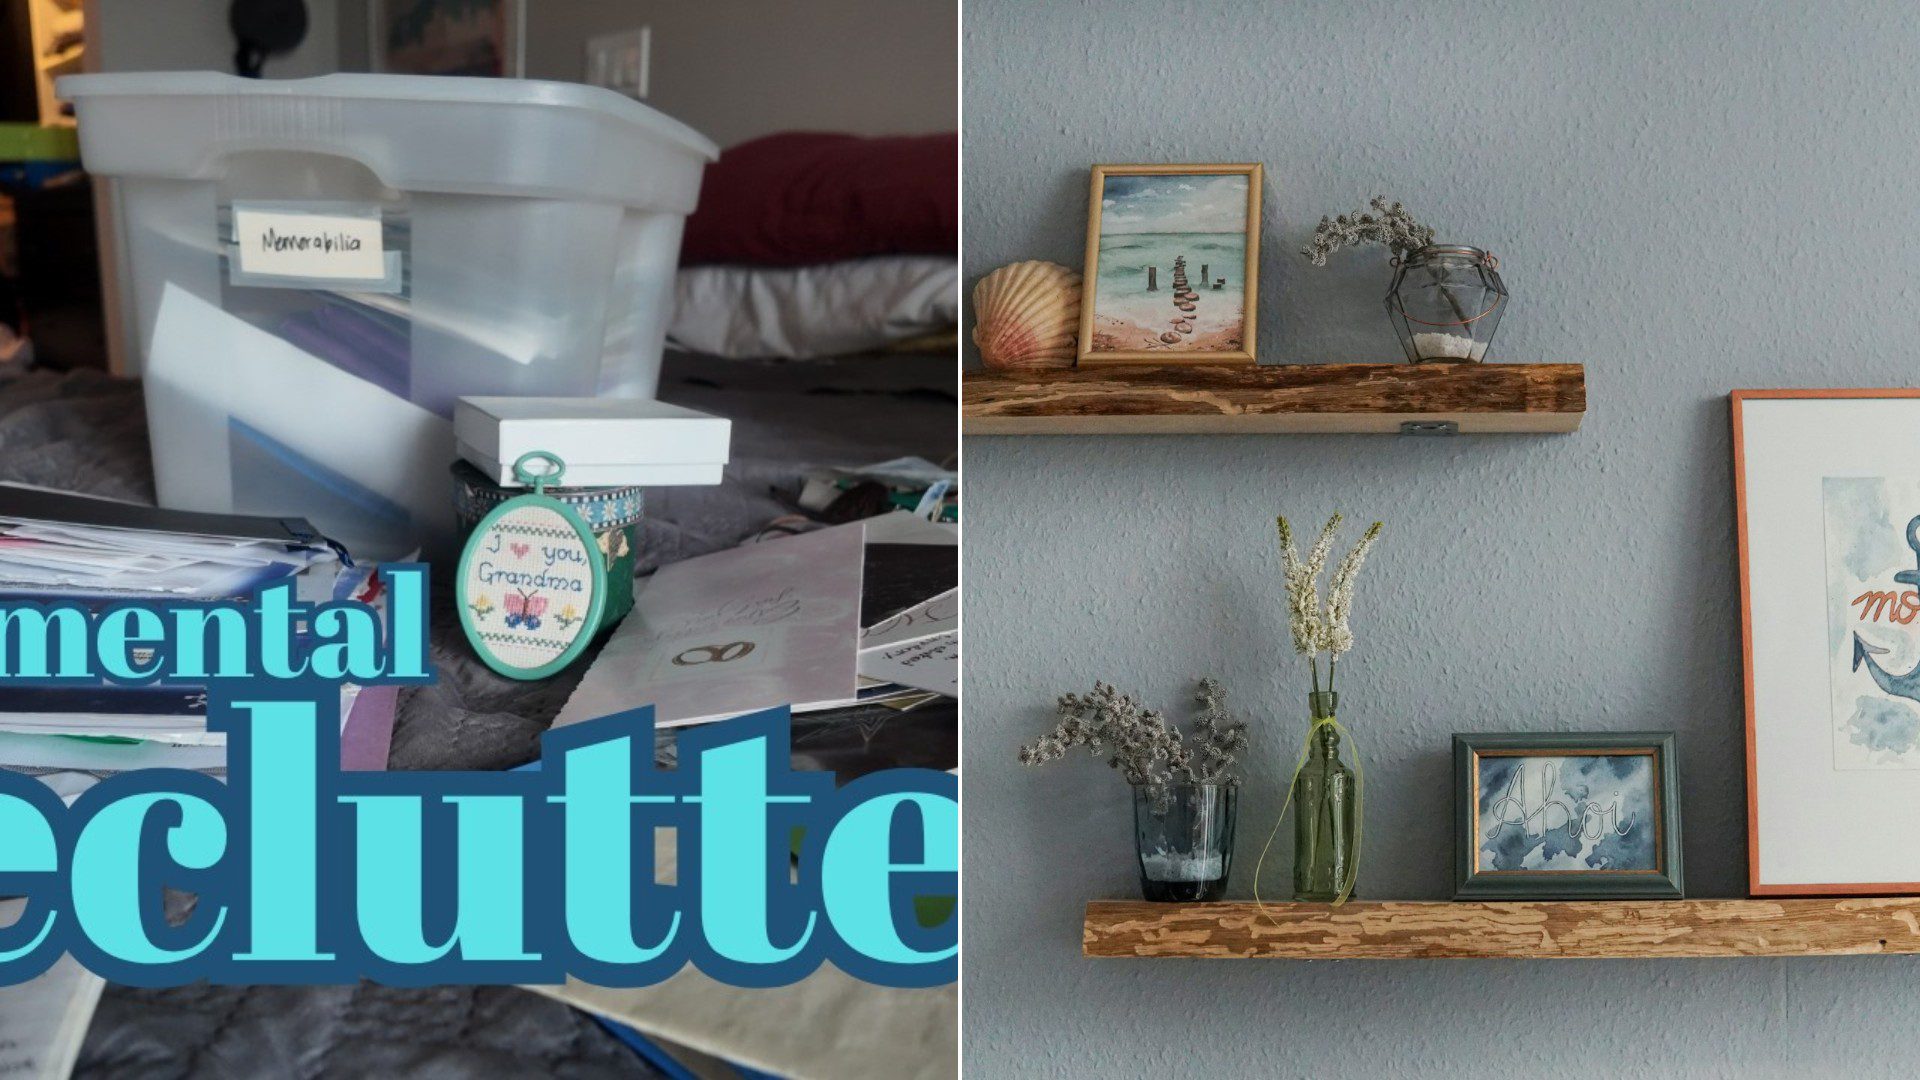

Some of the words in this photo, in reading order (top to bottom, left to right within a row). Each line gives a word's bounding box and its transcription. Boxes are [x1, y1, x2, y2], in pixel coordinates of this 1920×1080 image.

[261, 226, 362, 254] Memorabilia
[479, 560, 584, 592] Grandma
[1484, 760, 1636, 841] Ahoi
